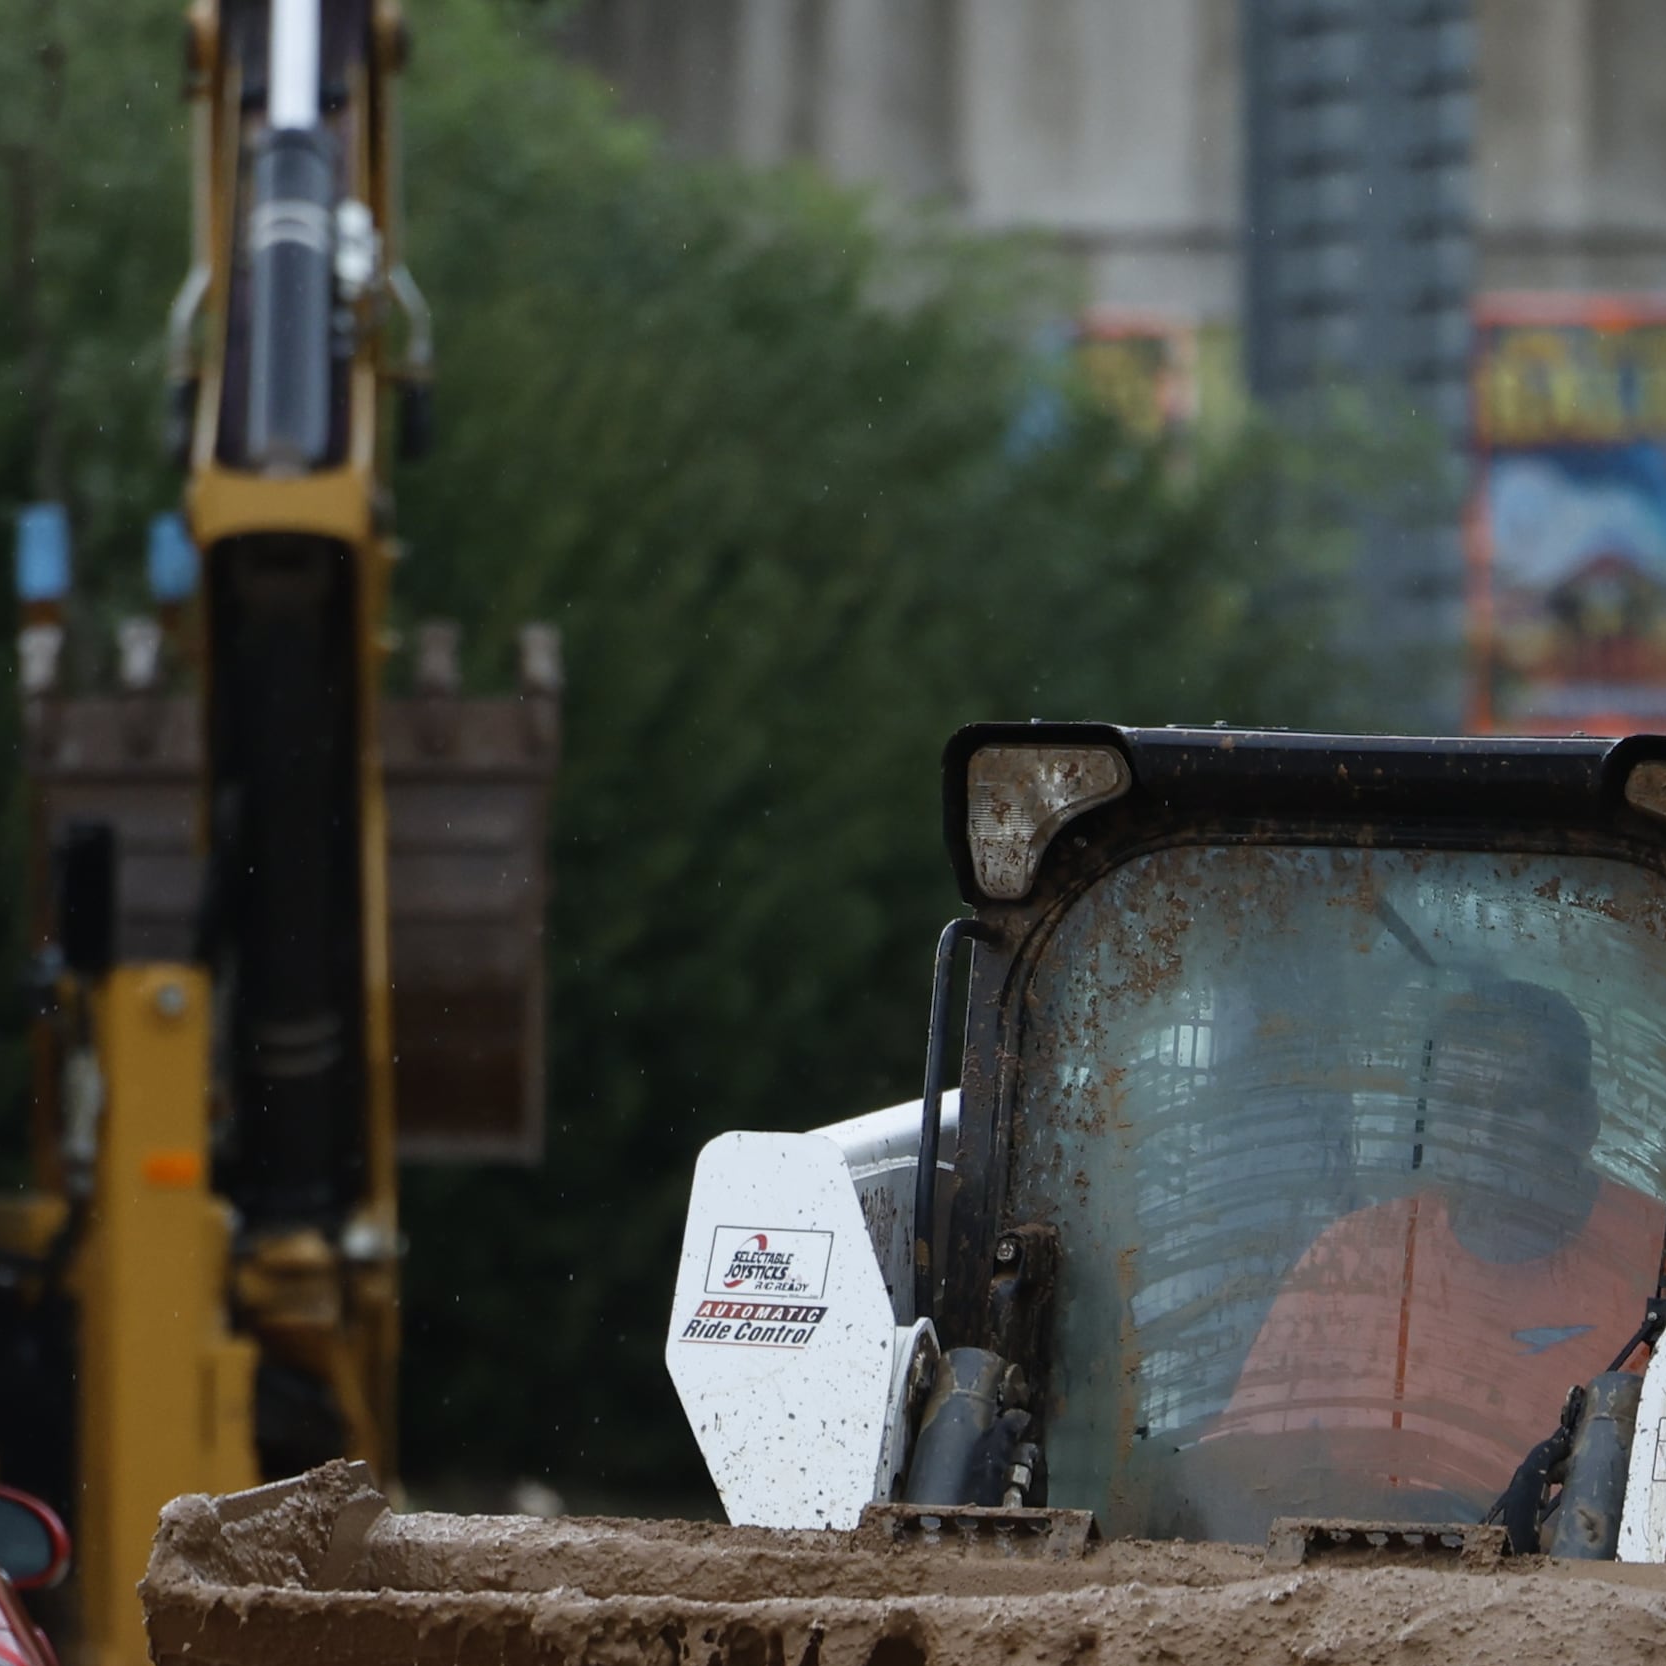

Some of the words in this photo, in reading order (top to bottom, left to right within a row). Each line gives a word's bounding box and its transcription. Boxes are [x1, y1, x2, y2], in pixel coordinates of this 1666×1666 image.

[732, 1250, 794, 1265] SELECTABLE
[724, 1263, 789, 1281] JOYSTICKS
[774, 1281, 810, 1293] READY
[699, 1302, 821, 1322] AUTOMATIC
[683, 1319, 732, 1339] Ride
[734, 1322, 816, 1344] Control
